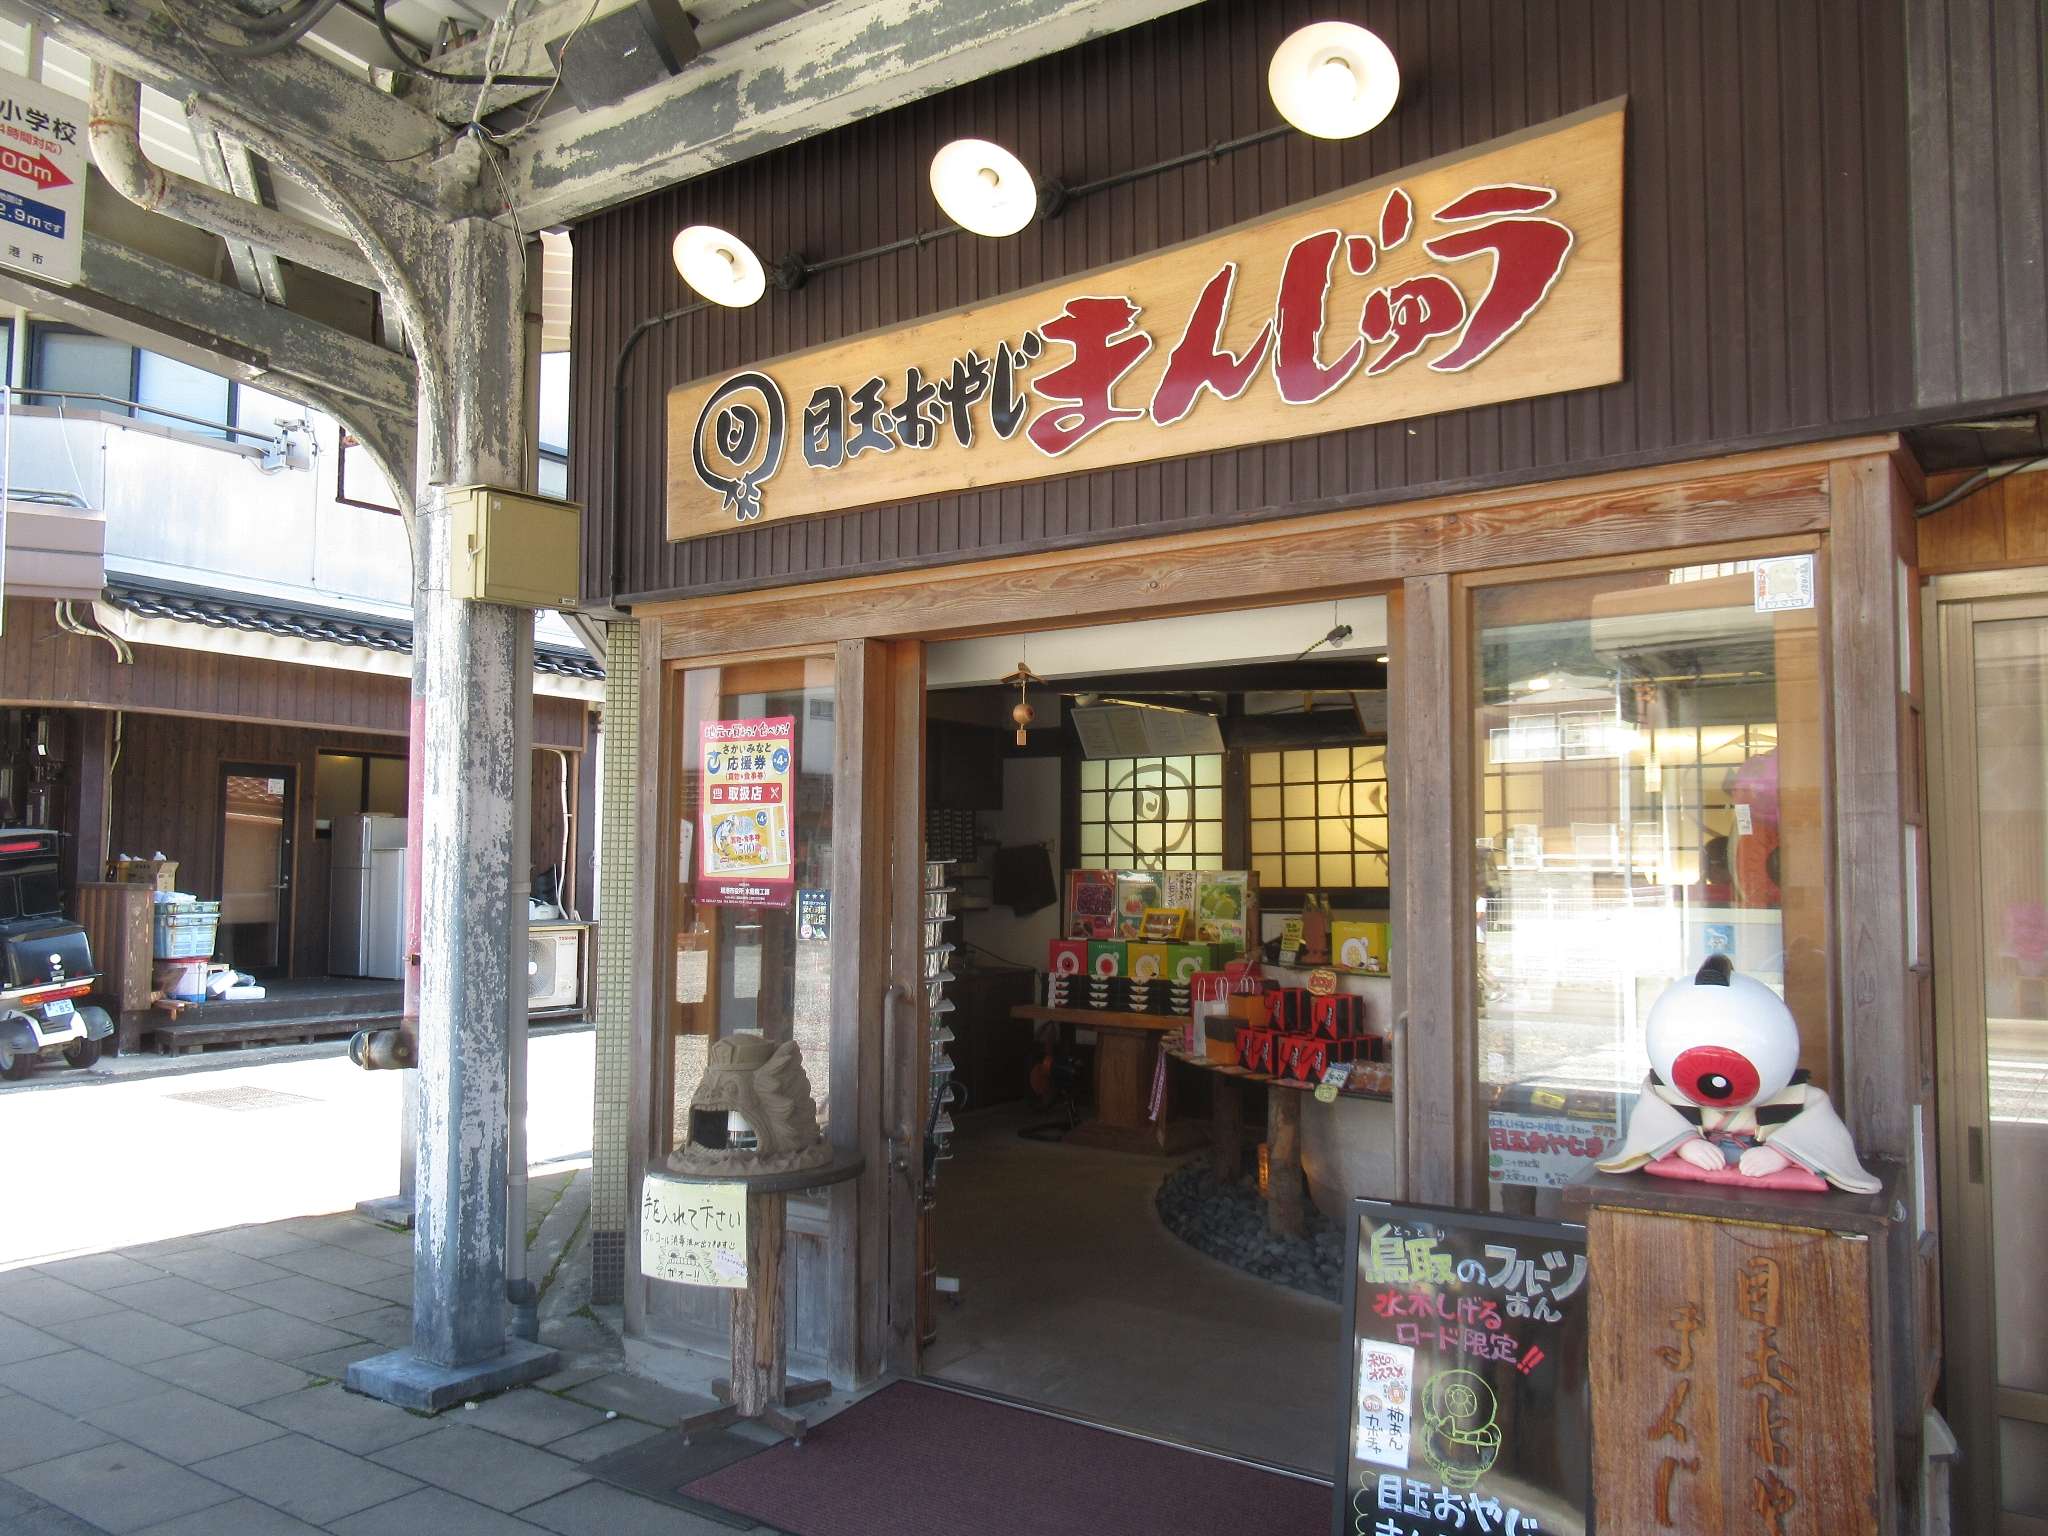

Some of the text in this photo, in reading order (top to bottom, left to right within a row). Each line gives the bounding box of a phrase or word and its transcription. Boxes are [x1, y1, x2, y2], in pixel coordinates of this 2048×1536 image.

[0, 99, 77, 146] 小学校
[802, 182, 1575, 470] 目玉おやじ まんじゅう
[722, 742, 772, 755] さかいみなと
[727, 755, 766, 771] 応援券
[728, 785, 763, 801] 取扱店
[1372, 1286, 1502, 1330] 水木しげる
[1506, 1292, 1562, 1322] あん
